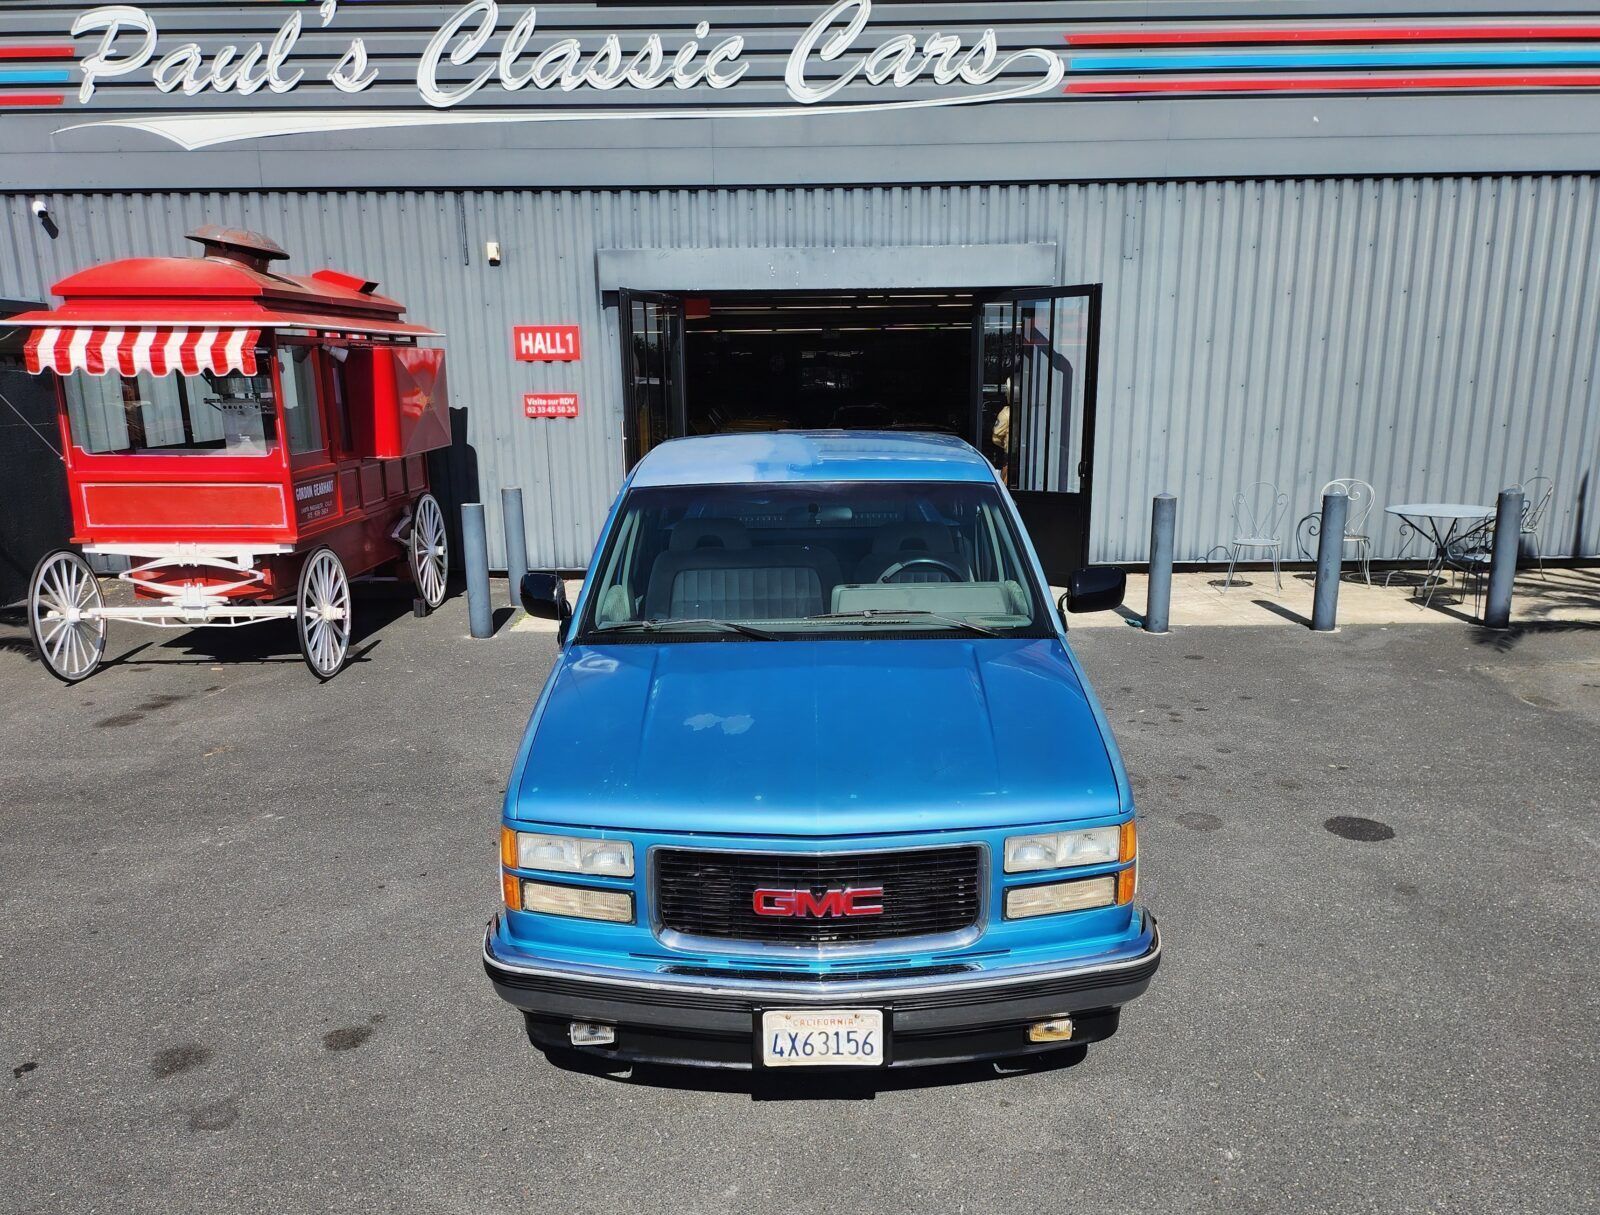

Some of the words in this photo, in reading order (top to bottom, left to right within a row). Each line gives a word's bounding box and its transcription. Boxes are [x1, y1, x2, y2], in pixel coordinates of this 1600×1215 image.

[70, 0, 380, 105] Paul's
[416, 0, 750, 108] Classic
[784, 0, 1065, 104] Cars
[527, 397, 547, 405] Visite
[560, 397, 575, 405] RDV
[752, 887, 883, 917] GMC
[793, 1018, 854, 1026] CALIFORNIA
[772, 1030, 875, 1057] 4X63156
